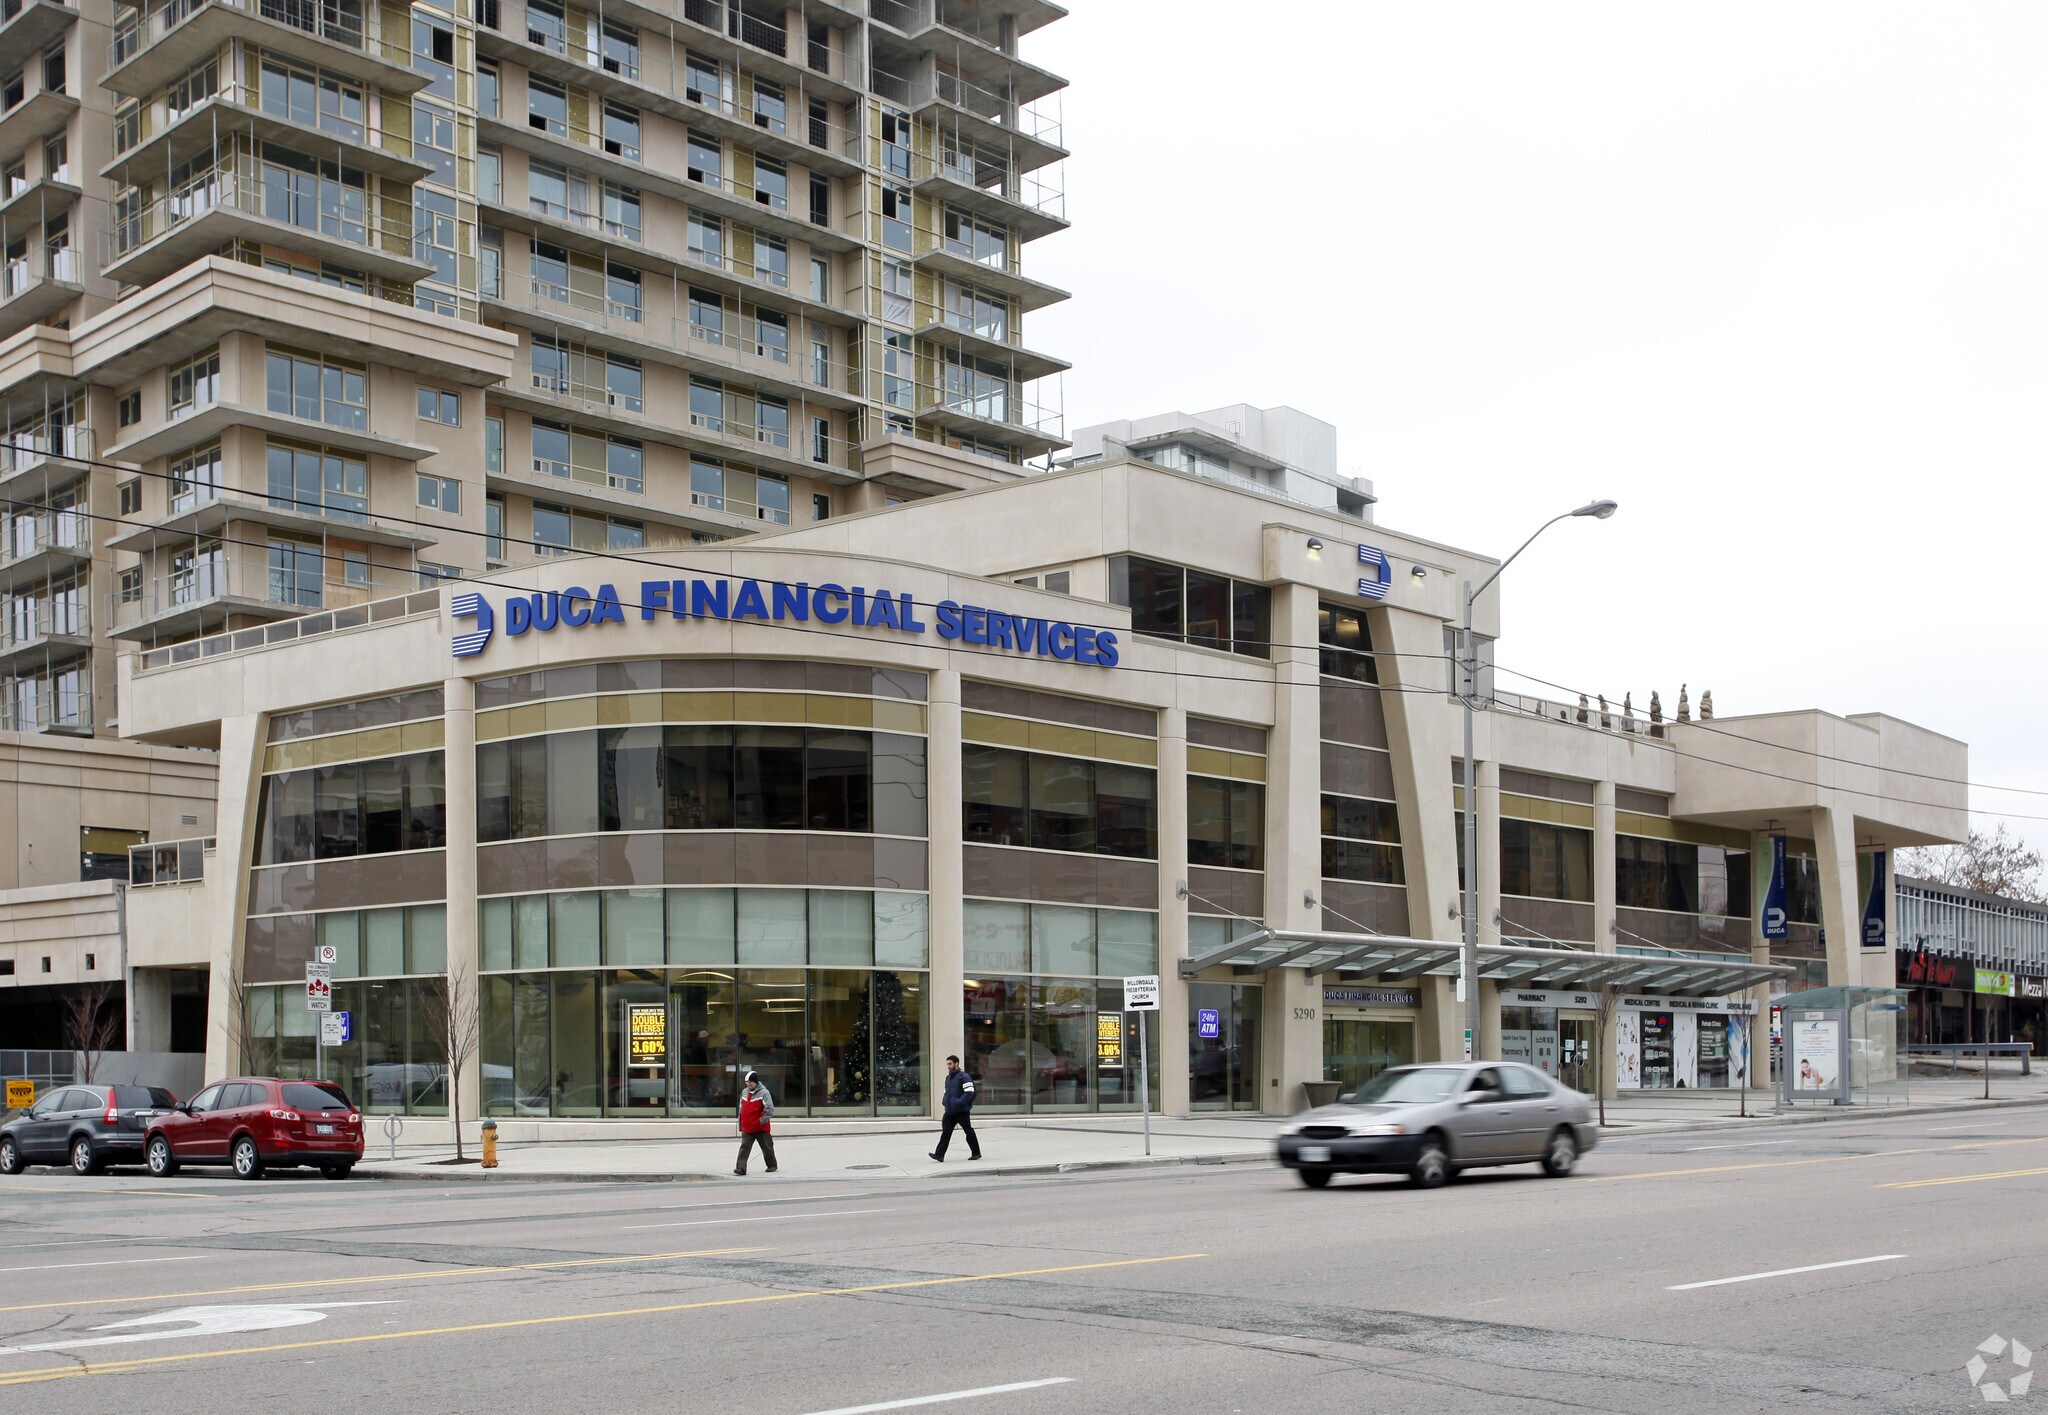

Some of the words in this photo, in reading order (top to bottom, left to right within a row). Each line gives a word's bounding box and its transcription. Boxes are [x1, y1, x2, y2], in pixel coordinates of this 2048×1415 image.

[506, 584, 625, 636] DUCA
[641, 580, 925, 633] FINANCIAL
[936, 600, 1119, 667] SERVICES
[2021, 977, 2042, 997] Mezza
[1324, 991, 1344, 1000] DUCA
[1345, 992, 1381, 1001] FINANCIAL
[1382, 993, 1415, 1003] SERVICES
[1517, 994, 1546, 1002] PHARMACY
[1624, 998, 1643, 1006] MEDICAL
[1644, 999, 1660, 1007] CENTRE
[1202, 1013, 1215, 1022] 24hr
[1293, 1008, 1315, 1020] 5290
[632, 1015, 665, 1025] DOUBLE
[632, 1025, 665, 1033] INTEREST
[1201, 1023, 1216, 1033] ATM
[632, 1040, 665, 1053] 3.60%
[1501, 1047, 1523, 1056] Pharmacy
